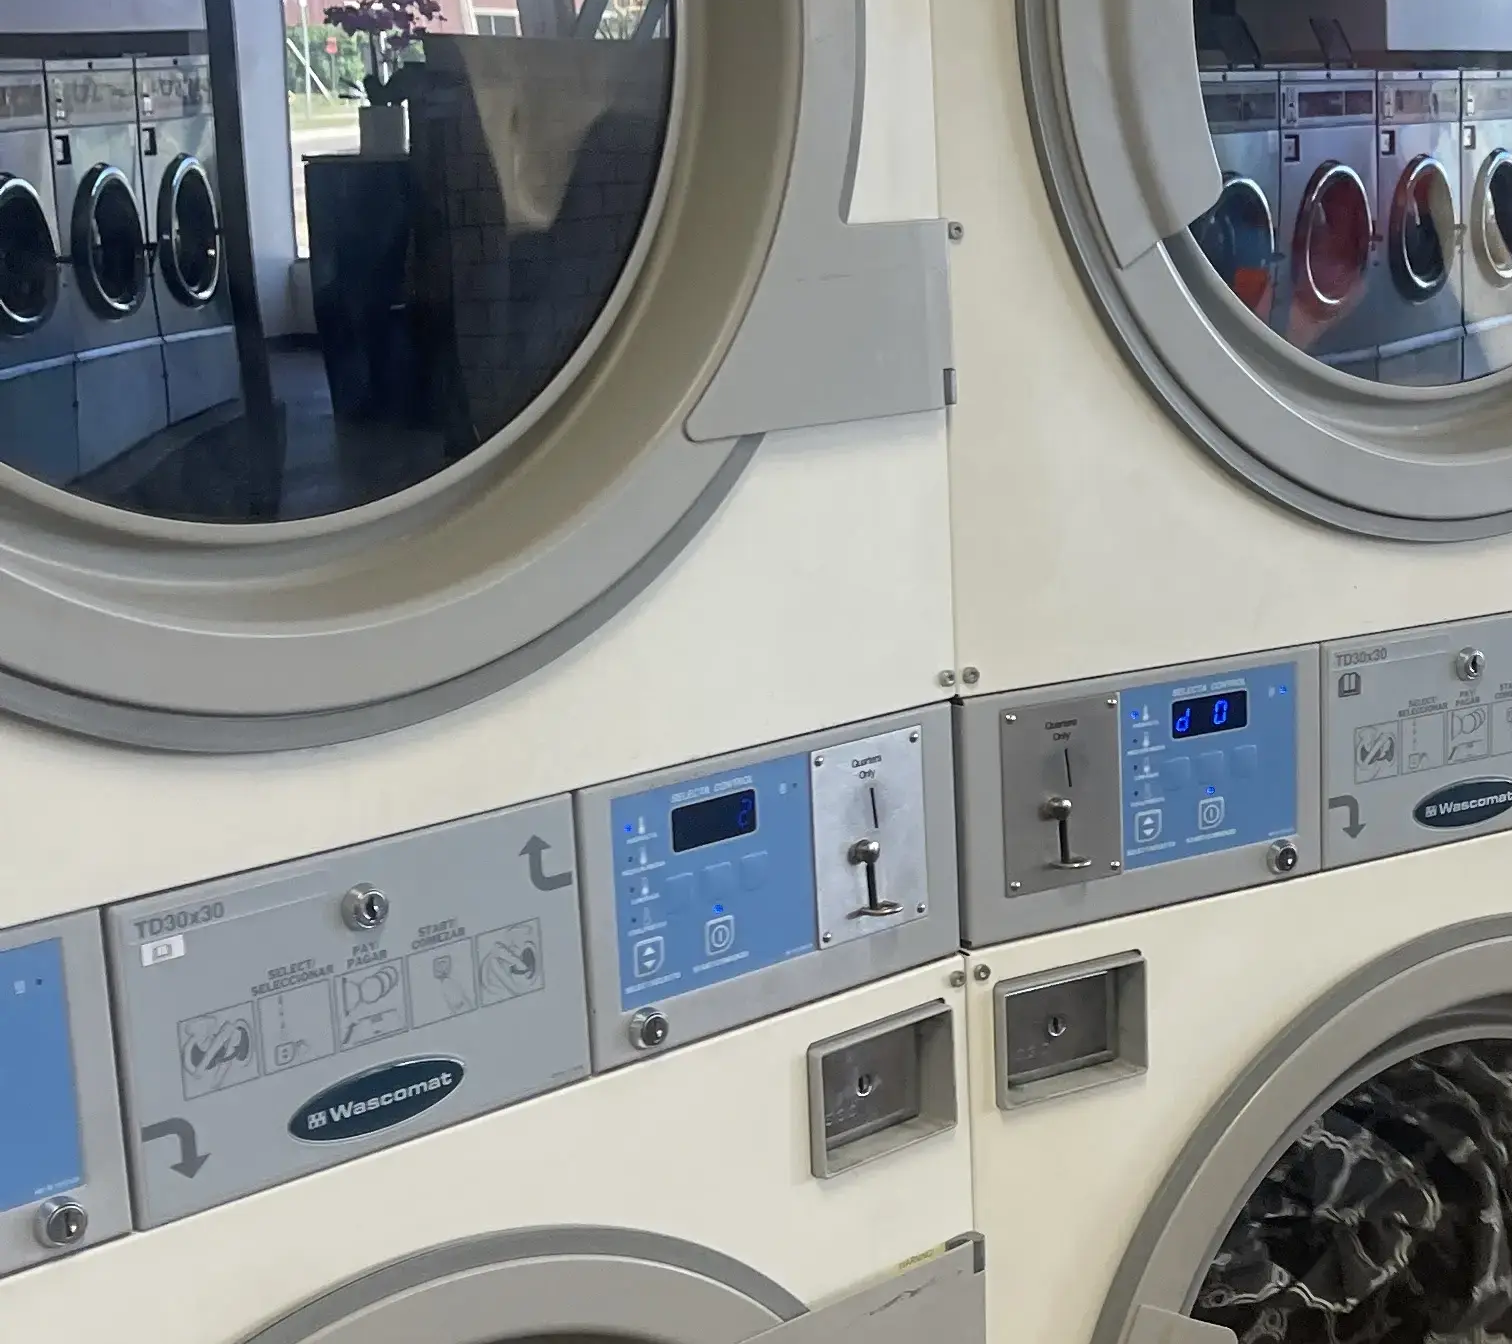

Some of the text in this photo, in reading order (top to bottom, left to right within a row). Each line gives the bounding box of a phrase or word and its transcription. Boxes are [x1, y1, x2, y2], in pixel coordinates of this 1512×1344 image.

[1335, 647, 1388, 667] TD30x30
[1175, 699, 1229, 732] d 0
[133, 901, 225, 939] TD30x30
[250, 964, 334, 997] SELECCIONAR
[329, 1071, 453, 1123] Wascomat
